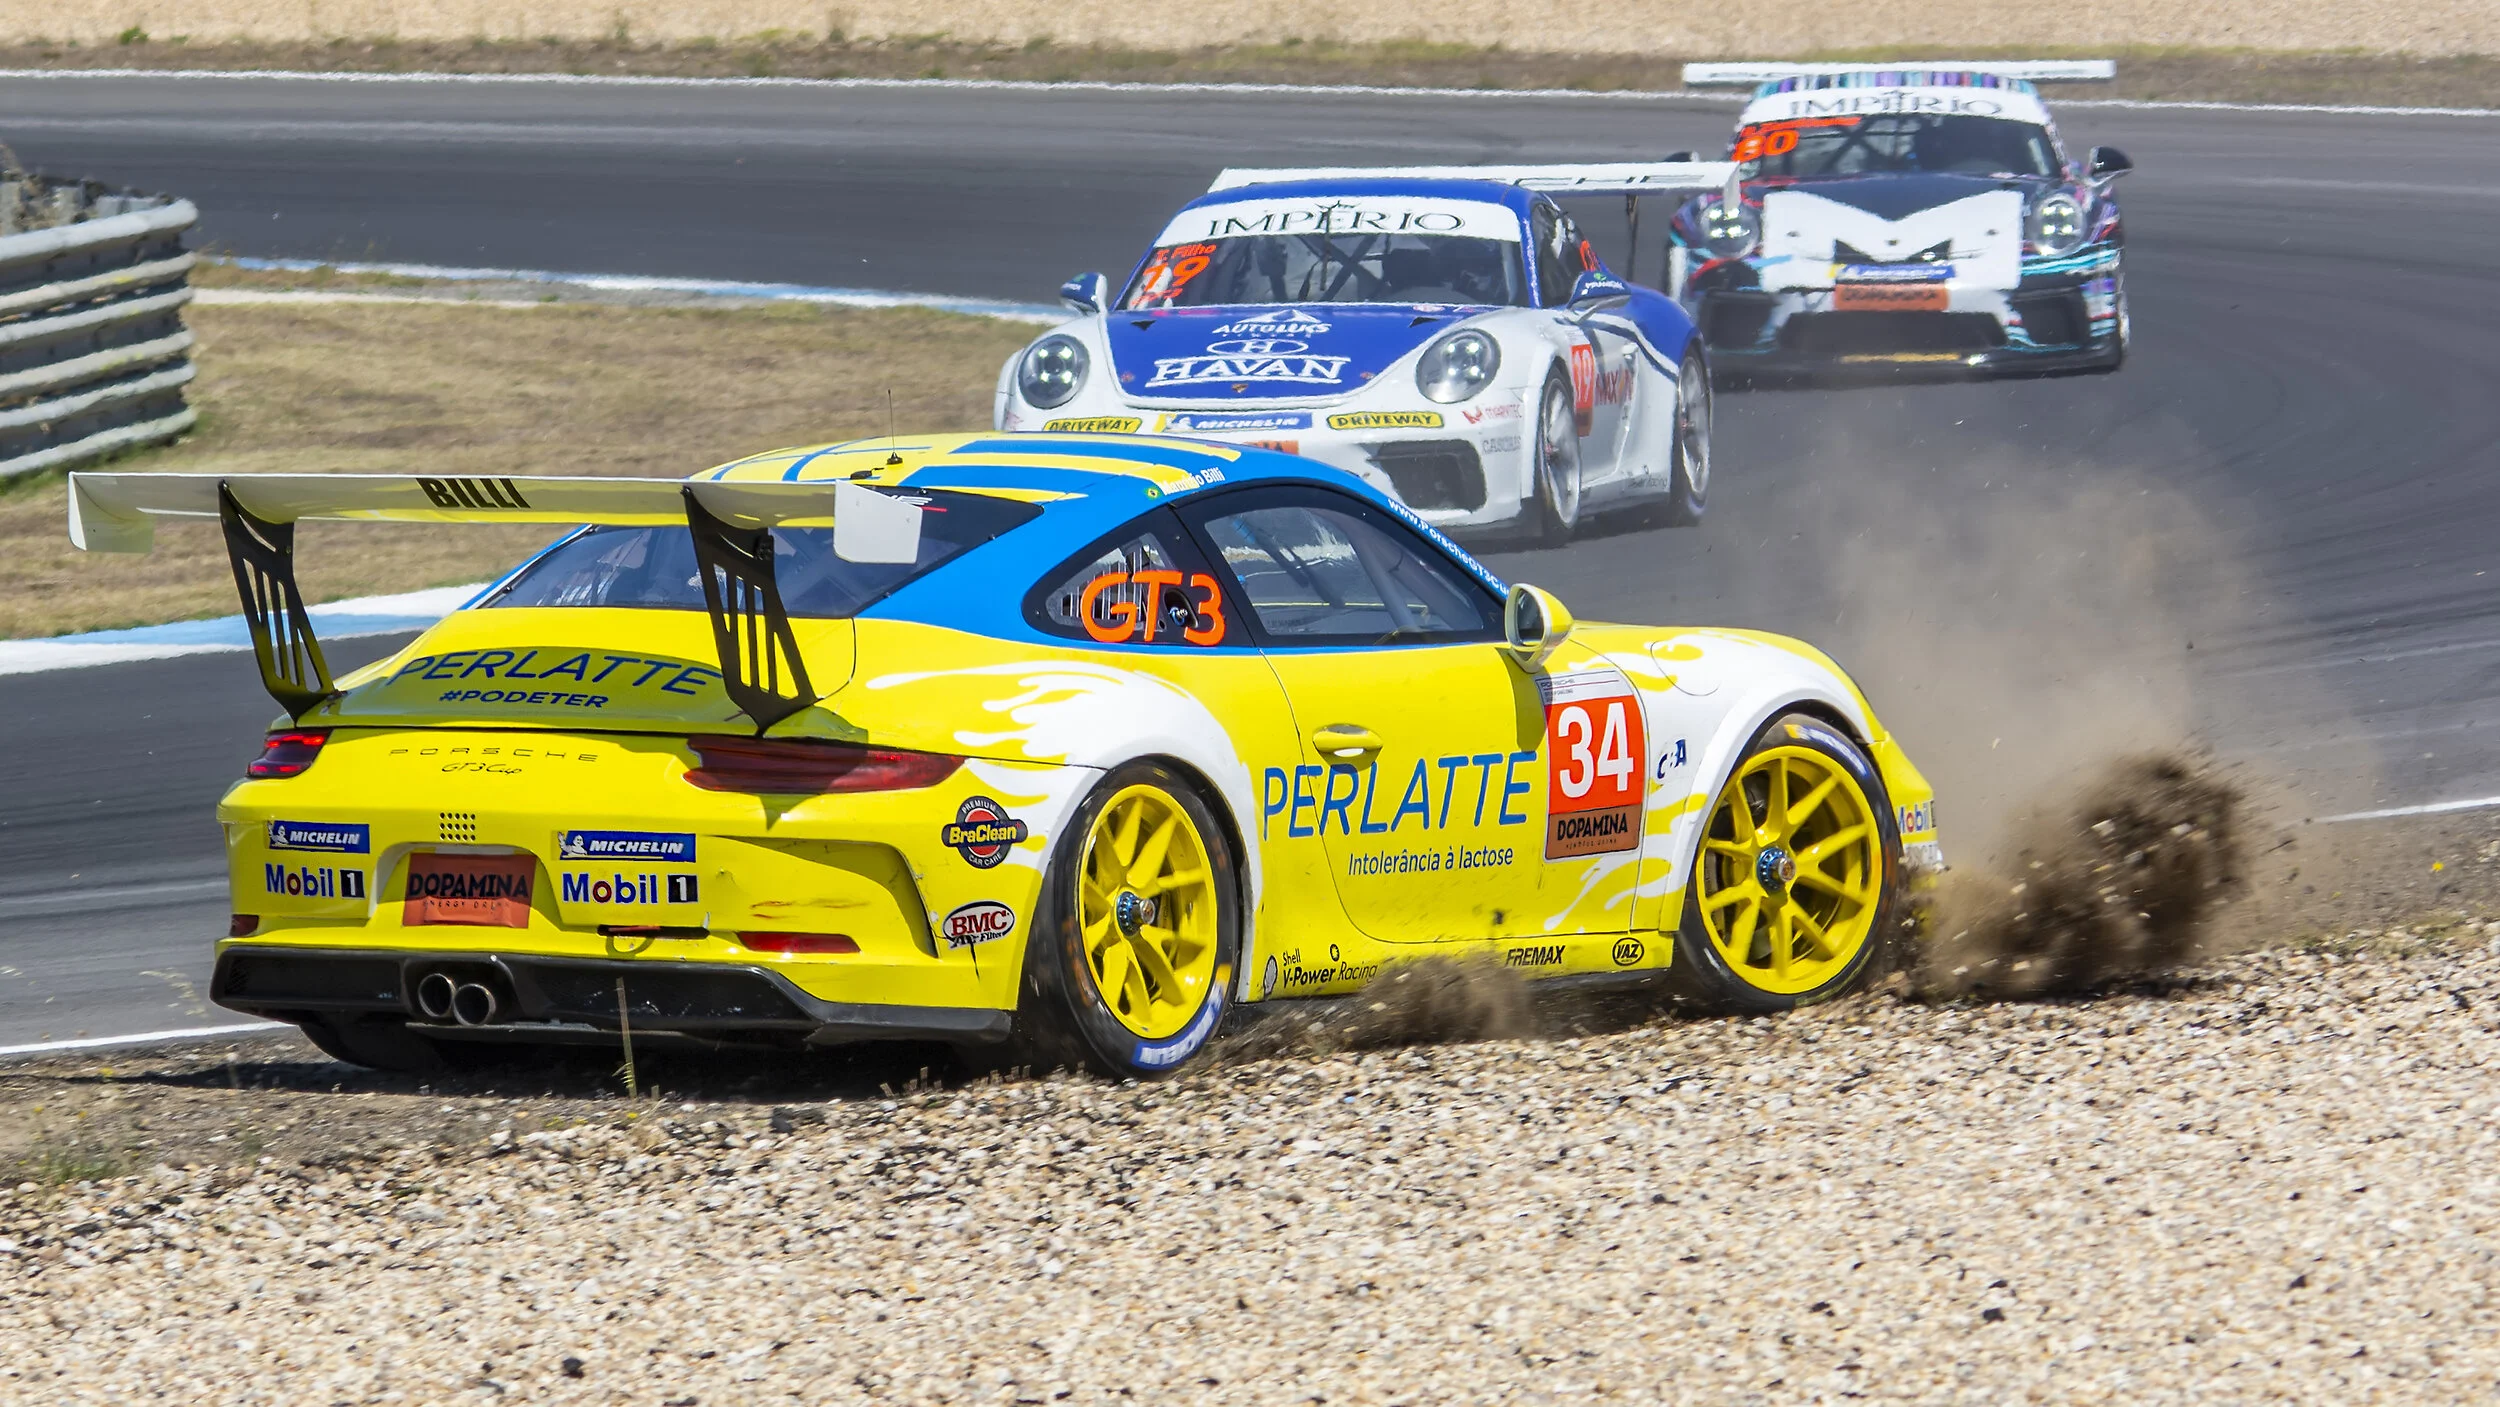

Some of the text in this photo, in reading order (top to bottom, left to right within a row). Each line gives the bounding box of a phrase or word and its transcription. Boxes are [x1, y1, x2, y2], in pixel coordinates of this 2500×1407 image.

[1732, 130, 1799, 163] 80
[1143, 255, 1210, 291] 19
[1149, 358, 1347, 382] HAVAN
[1048, 419, 1134, 432] DRIVEWAY
[1196, 415, 1301, 429] MICHELIN
[1337, 413, 1433, 427] DRIVEWAY
[1200, 467, 1226, 484] Billi
[415, 478, 531, 508] BILLI
[1080, 569, 1226, 646] GT3
[384, 650, 724, 696] PERLATTE
[439, 689, 609, 708] #PODETER
[389, 746, 599, 762] PORSCHE
[1558, 701, 1634, 799] 34
[961, 799, 998, 815] PREMIUM
[1263, 750, 1537, 842] PERLATTE
[290, 829, 361, 846] MICHELIN
[949, 825, 1017, 845] BraClean
[1557, 813, 1628, 841] DOPAMINA
[589, 840, 684, 854] MICHELIN
[968, 851, 1003, 867] CAR CARE
[1348, 844, 1514, 876] Intolerância à lactose
[264, 862, 335, 898] Mobil
[409, 873, 529, 898] DOPAMINA
[562, 872, 658, 904] Mobil
[950, 910, 1007, 937] BMC
[1282, 947, 1301, 967] Shell
[1504, 945, 1566, 967] FREMAX
[1615, 943, 1640, 959] VAZ
[1282, 961, 1379, 988] V-Power Racing
